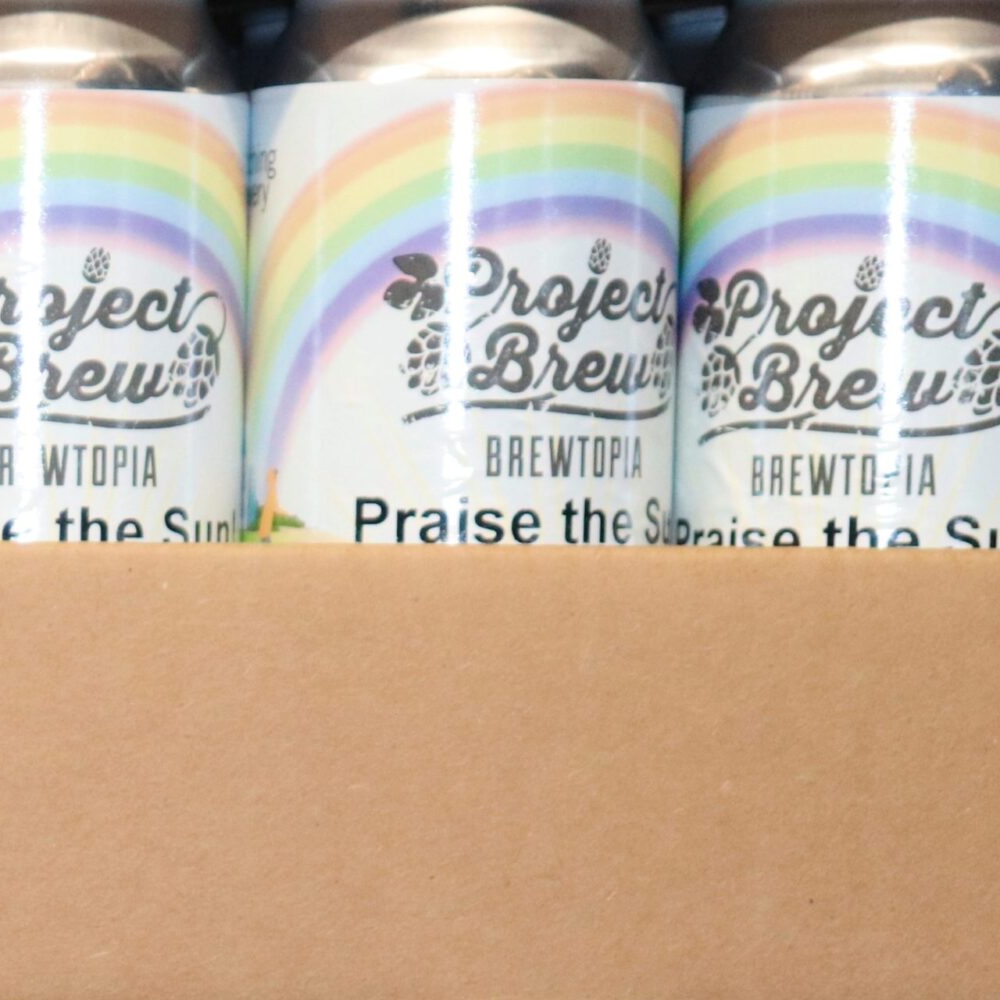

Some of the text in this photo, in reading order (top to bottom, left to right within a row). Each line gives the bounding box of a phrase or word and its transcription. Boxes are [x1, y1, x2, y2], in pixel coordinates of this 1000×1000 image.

[467, 321, 653, 394] Brew
[486, 434, 642, 479] BREWTOPIA
[751, 453, 937, 497] BREWTOIA
[354, 496, 551, 545] Praise
[561, 496, 633, 545] the
